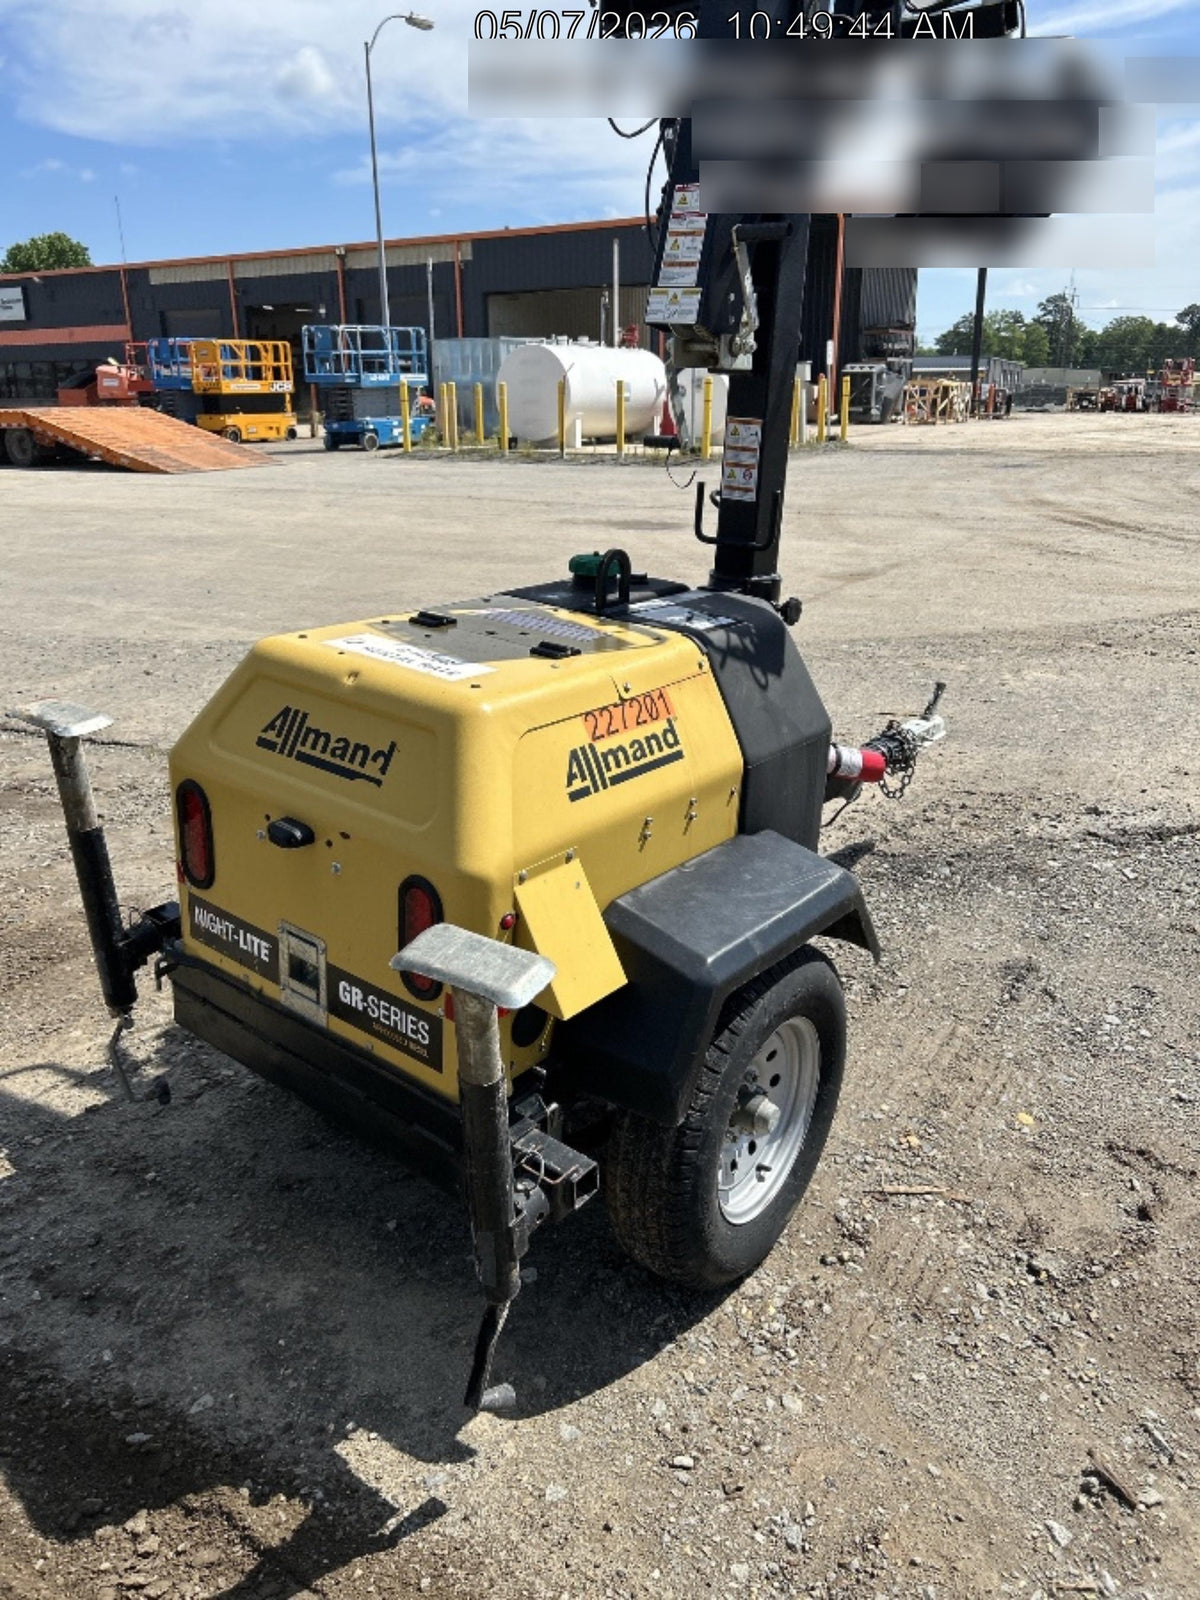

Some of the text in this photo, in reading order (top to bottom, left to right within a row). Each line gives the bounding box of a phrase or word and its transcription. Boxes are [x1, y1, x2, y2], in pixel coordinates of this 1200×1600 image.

[270, 382, 293, 392] JCB
[583, 688, 672, 741] 227201
[566, 716, 681, 794] Allmand
[194, 905, 270, 963] NIGHT-LITE
[338, 980, 430, 1045] GR-SERIES
